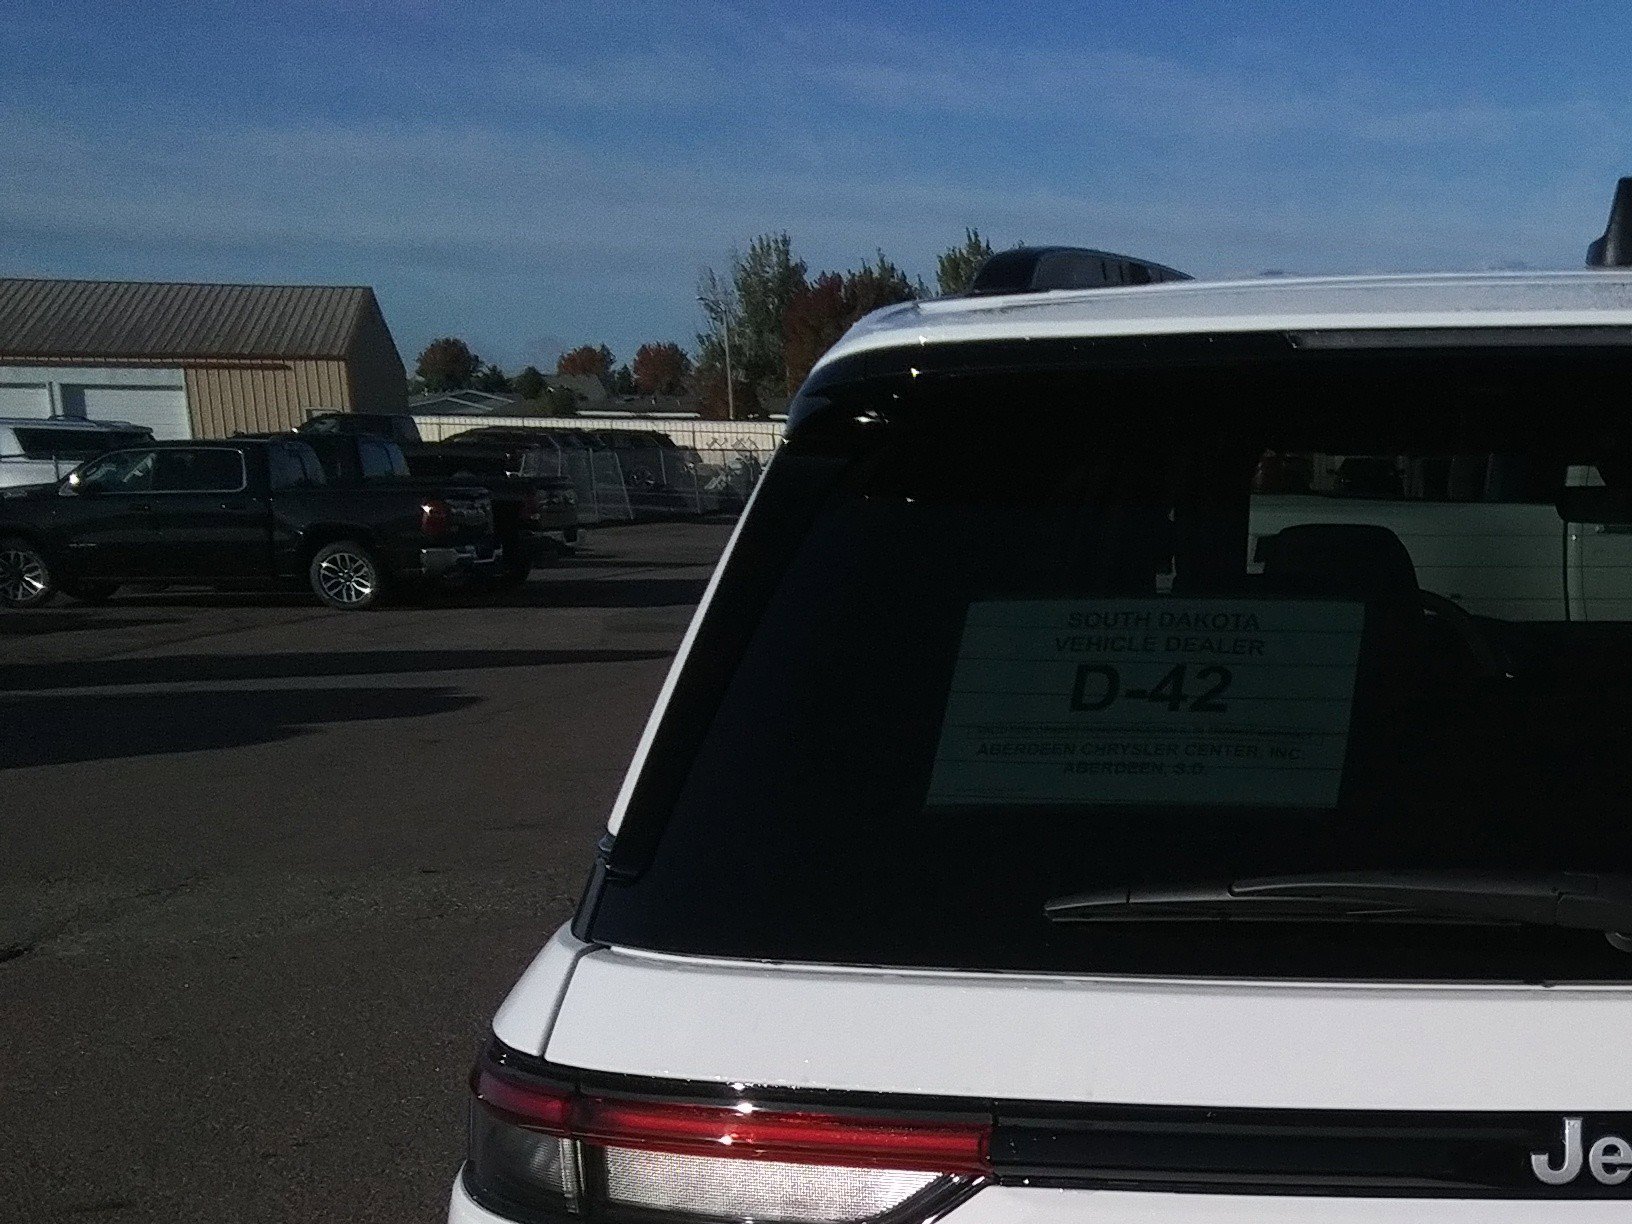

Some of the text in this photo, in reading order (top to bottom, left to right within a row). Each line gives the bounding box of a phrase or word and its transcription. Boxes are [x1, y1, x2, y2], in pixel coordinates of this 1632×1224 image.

[1067, 611, 1260, 631] SOUTH DAKOTA
[1054, 636, 1265, 656] VEHICLE DEALER
[1069, 663, 1232, 712] D-42
[976, 742, 1076, 758] ABERDEEN
[1080, 742, 1179, 758] CHRYSLER
